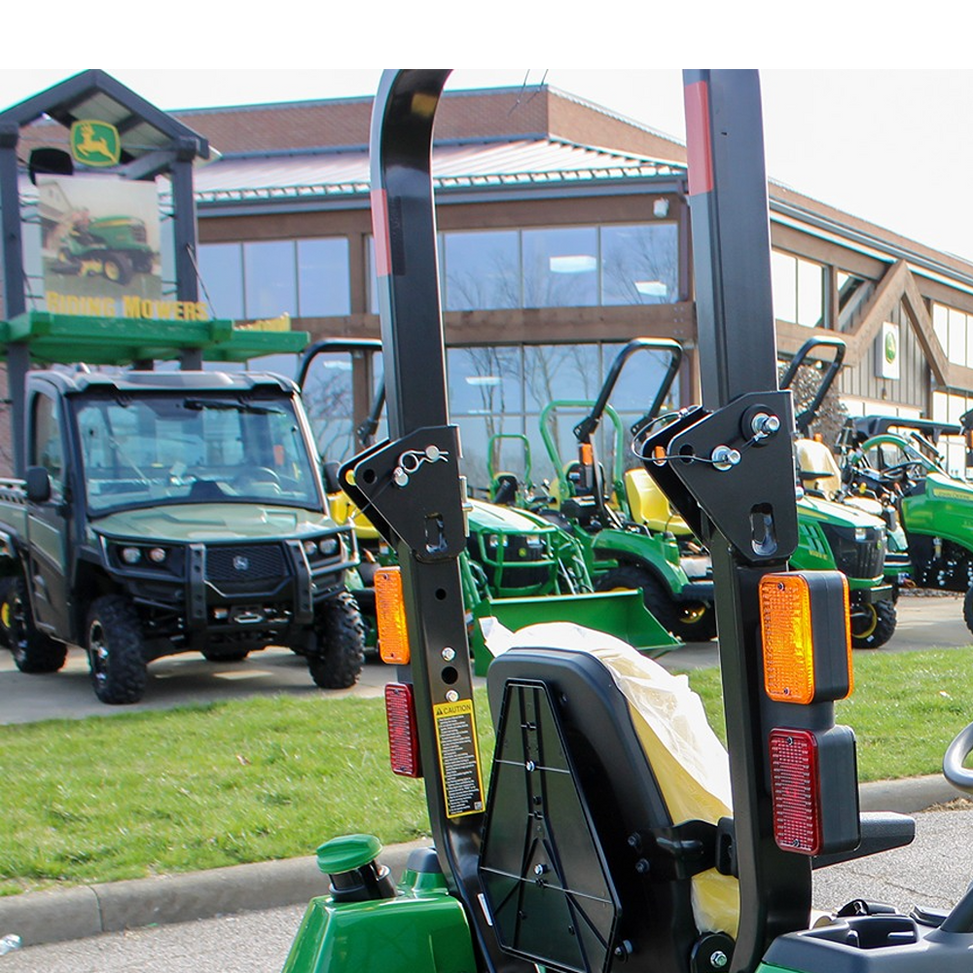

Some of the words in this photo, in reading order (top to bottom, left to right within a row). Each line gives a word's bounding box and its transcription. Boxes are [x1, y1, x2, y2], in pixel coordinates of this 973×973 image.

[46, 291, 116, 317] RIDING
[122, 295, 208, 320] MOWERS
[443, 704, 471, 715] CAUTION
